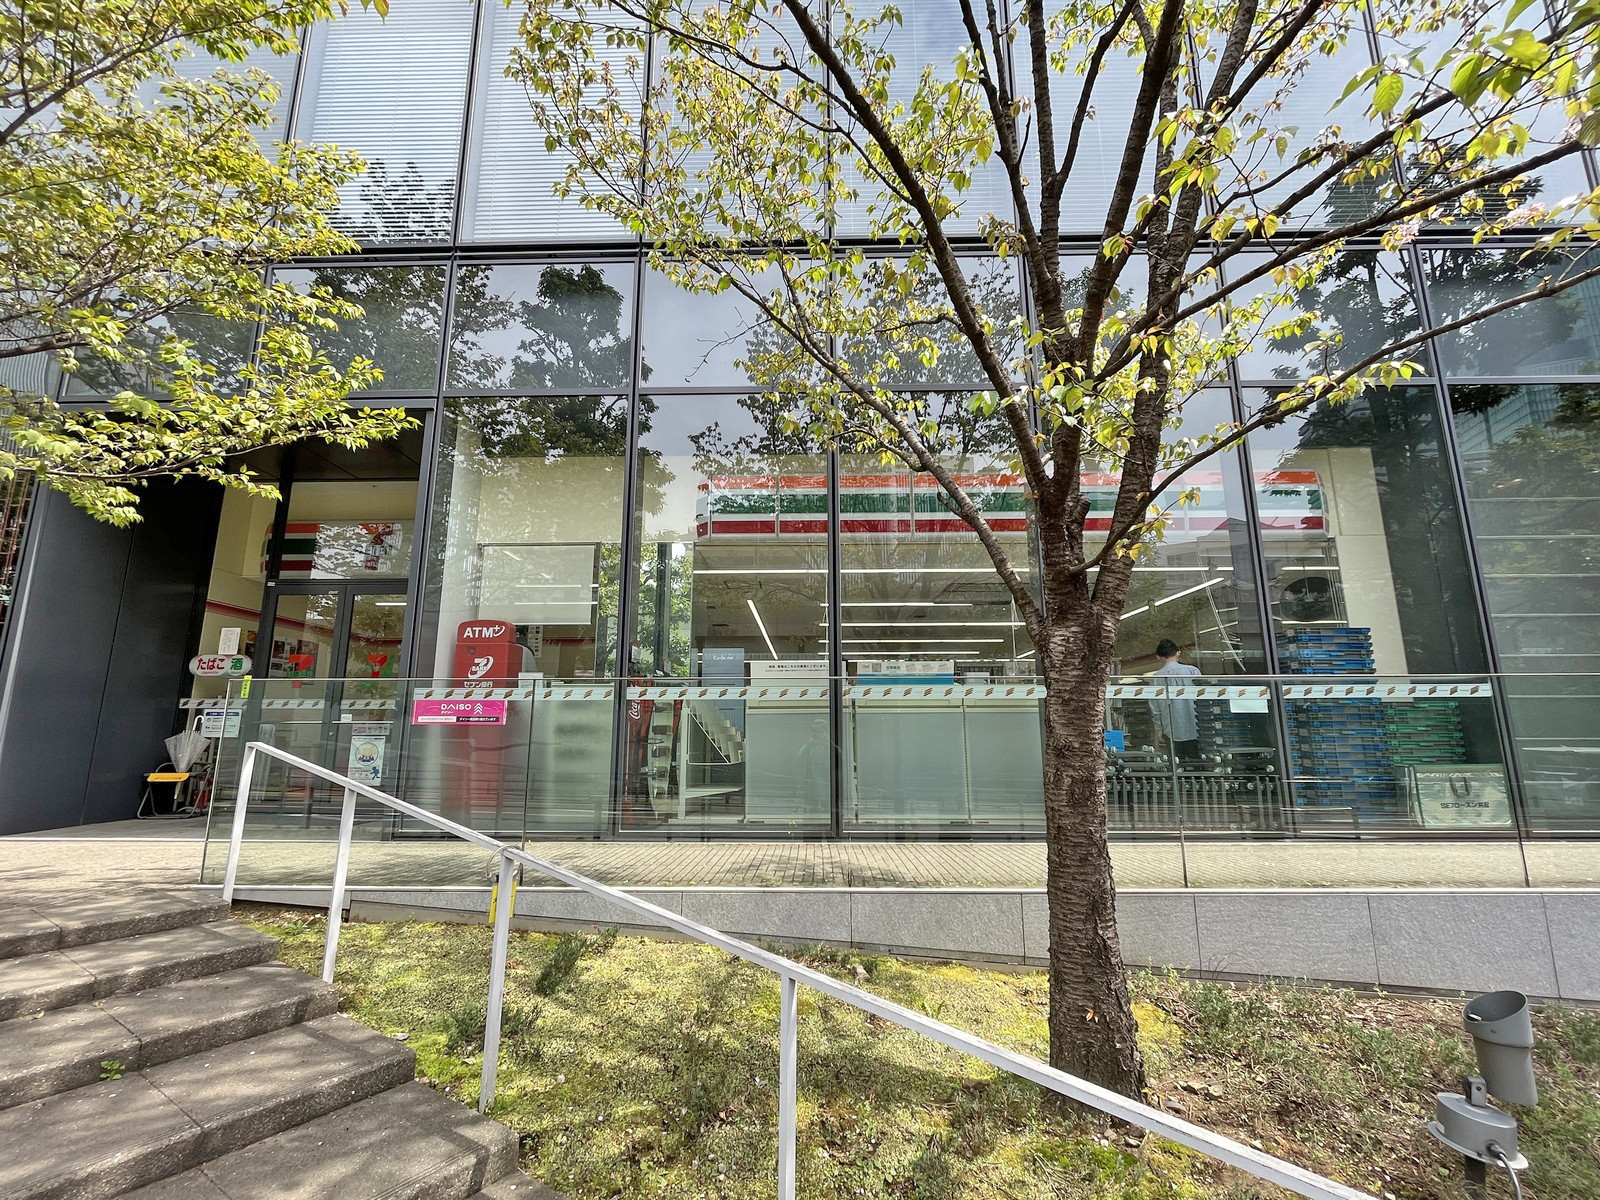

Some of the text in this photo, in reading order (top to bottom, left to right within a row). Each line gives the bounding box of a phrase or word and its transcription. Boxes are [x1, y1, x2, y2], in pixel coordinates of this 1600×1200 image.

[196, 657, 244, 671] たばこ 酒
[440, 703, 472, 711] DAISO
